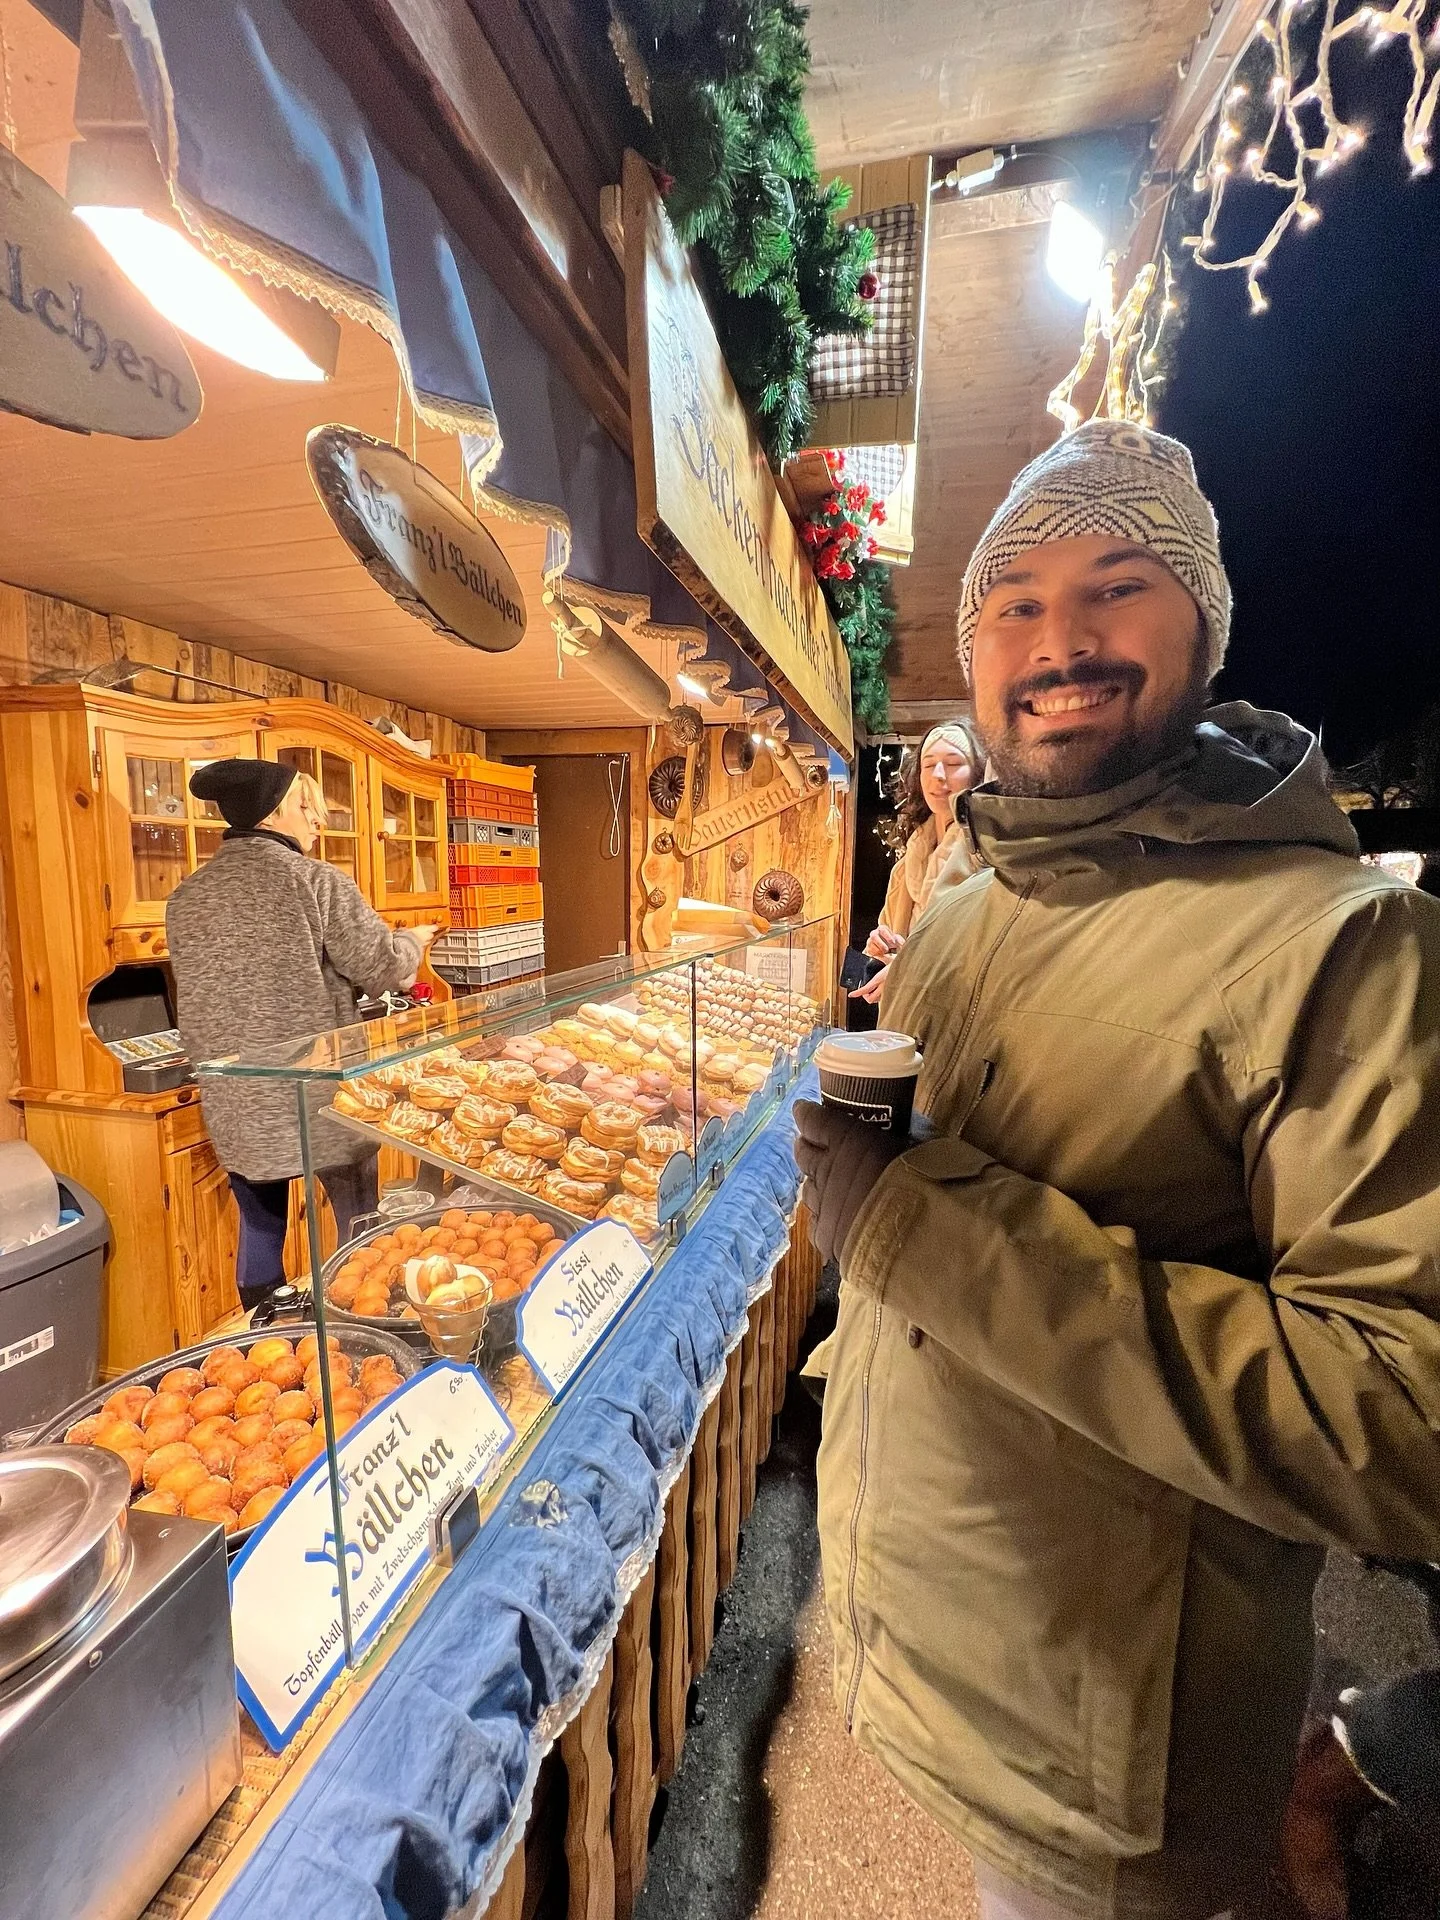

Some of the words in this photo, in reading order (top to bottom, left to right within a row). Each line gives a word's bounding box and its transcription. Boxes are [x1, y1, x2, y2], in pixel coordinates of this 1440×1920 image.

[0, 239, 188, 412] lchen
[360, 469, 446, 574] Franz'l
[449, 541, 524, 627] Bällchen
[554, 1261, 624, 1337] Bällchen
[560, 1250, 591, 1285] Sissi
[304, 1437, 454, 1598] Bällchen
[313, 1409, 411, 1507] Franz'l
[283, 1601, 370, 1697] Topfenbällhen
[368, 1576, 385, 1601] mit
[463, 1453, 477, 1474] und
[474, 1429, 497, 1458] Zucker
